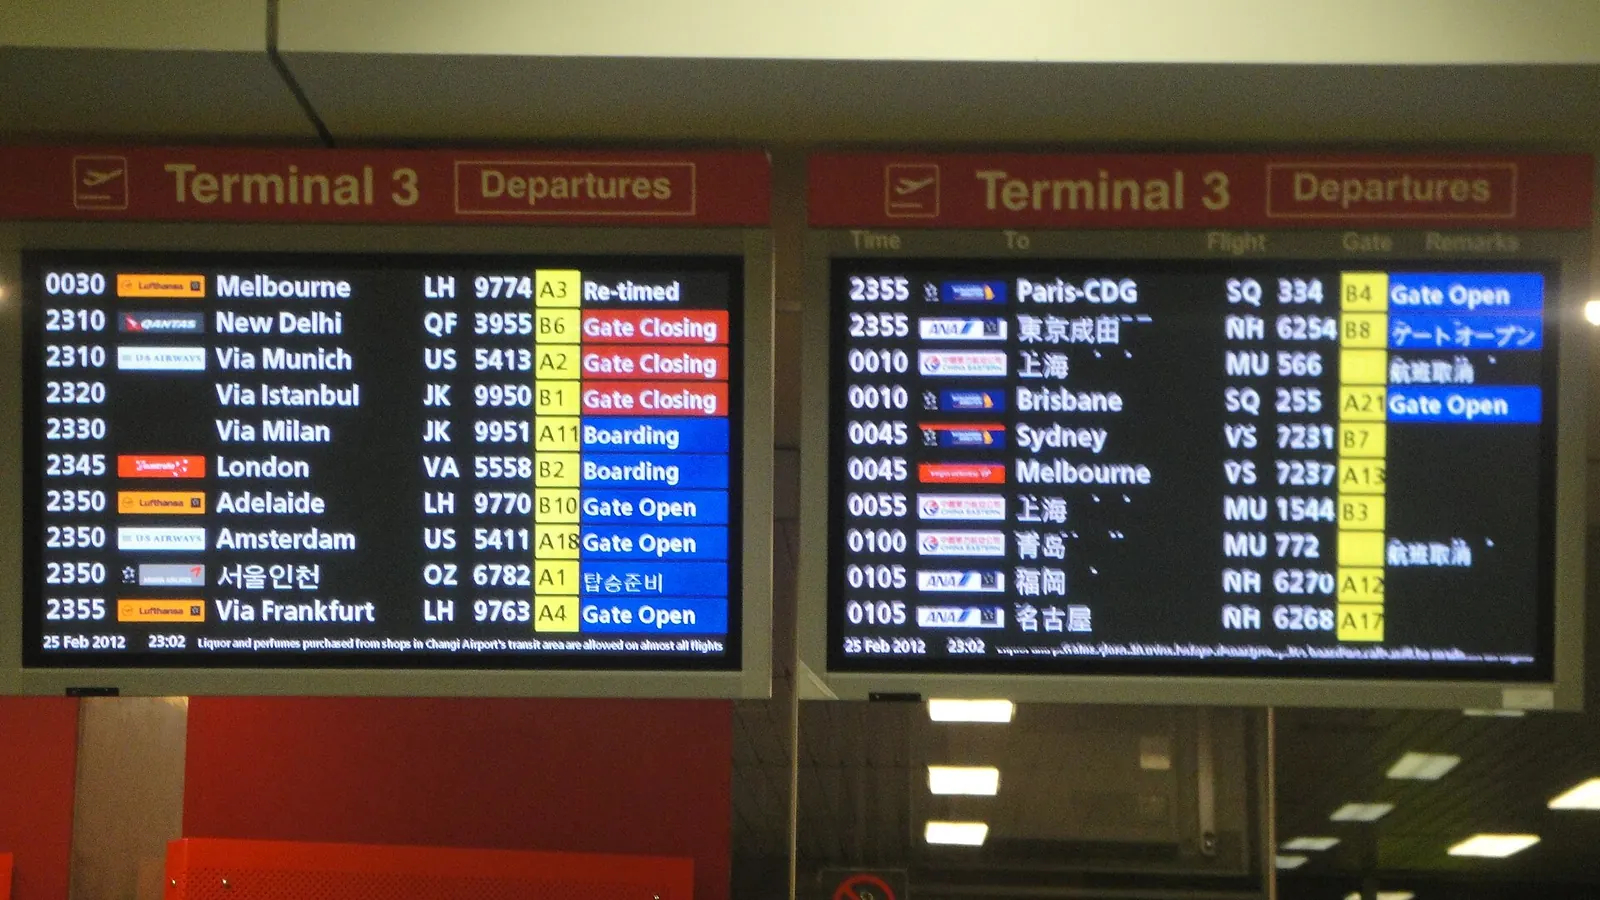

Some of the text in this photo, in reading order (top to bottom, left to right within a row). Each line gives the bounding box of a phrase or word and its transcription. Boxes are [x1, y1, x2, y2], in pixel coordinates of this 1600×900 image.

[164, 163, 419, 207] Terminal 3
[480, 169, 672, 204] Departures
[976, 170, 1230, 212] Terminal 3
[1292, 172, 1491, 208] Departures
[851, 230, 901, 250] Time
[1005, 231, 1030, 249] To
[1207, 232, 1267, 255] Flight
[1342, 233, 1393, 251] Gate
[1425, 234, 1520, 252] Remarks
[46, 272, 105, 294] 0030
[217, 274, 351, 297] Melbourne
[425, 276, 532, 298] LH 9774
[540, 282, 566, 297] A3
[584, 281, 679, 301] Re-timed
[851, 277, 909, 301] 2355
[1017, 279, 1137, 303] Paris-CDG
[1227, 279, 1323, 306] SQ 334
[1346, 285, 1371, 301] B4
[1388, 284, 1510, 310] Gate Open
[46, 309, 105, 330] 2310
[142, 319, 197, 330] QANTAS
[217, 311, 341, 333] New Delhi
[424, 312, 532, 336] QF 3955
[541, 318, 564, 333] B6
[584, 317, 717, 342] Gate Closing
[850, 313, 908, 336] 2355
[929, 324, 959, 335] ANA
[1017, 315, 1119, 344] 東京成田
[1226, 316, 1338, 340] NH 6254
[1346, 322, 1370, 338] B8
[1393, 322, 1535, 346] ゲートオープン
[47, 345, 105, 367] 2310
[216, 347, 351, 370] Via Munich
[425, 348, 531, 370] US 5413
[540, 354, 566, 369] A2
[584, 353, 716, 378] Gate Closing
[849, 349, 908, 373] 0010
[1018, 351, 1068, 379] 上海
[1226, 352, 1322, 376] MU 566
[47, 382, 105, 403] 2320
[216, 383, 359, 405] Via Istanbul
[424, 384, 532, 406] JK 9950
[540, 390, 564, 405] B1
[583, 390, 716, 414] Gate Closing
[849, 385, 908, 408] 0010
[1017, 387, 1122, 411] Brisbane
[1226, 388, 1321, 415] SQ 255
[1344, 395, 1384, 411] A21
[1386, 394, 1508, 419] Gate Open
[47, 418, 105, 439] 2330
[216, 419, 330, 441] Via Milan
[423, 420, 528, 442] JK 9951
[540, 426, 579, 442] A11
[584, 425, 679, 449] Boarding
[848, 421, 907, 445] 0045
[1017, 423, 1107, 453] Sydney
[1225, 424, 1333, 449] VS 7231
[1344, 431, 1369, 447] B7
[47, 454, 105, 475] 2345
[218, 455, 309, 477] London
[423, 456, 531, 478] VA 5558
[540, 461, 563, 477] B2
[584, 461, 679, 485] Boarding
[848, 457, 907, 480] 0045
[1016, 459, 1151, 484] Melbourne
[1224, 461, 1335, 485] VS 7237
[47, 490, 105, 511] 2350
[216, 491, 325, 513] Adelaide
[425, 492, 531, 514] LH 9770
[540, 497, 577, 513] B10
[583, 498, 696, 521] Gate Open
[848, 493, 907, 516] 0055
[1018, 495, 1067, 523] 上海
[1224, 497, 1335, 521] MU 1544
[1343, 504, 1368, 520] B3
[47, 526, 105, 547] 2350
[216, 528, 355, 549] Amsterdam
[425, 528, 528, 549] US 5411
[539, 533, 580, 550] A18
[583, 533, 696, 557] Gate Open
[848, 529, 906, 552] 0100
[1224, 532, 1319, 557] MU 772
[47, 562, 105, 583] 2350
[218, 564, 319, 589] 서울인천
[424, 564, 530, 585] OZ 6782
[539, 569, 563, 585] A1
[584, 573, 662, 592] 탑승준비
[847, 565, 906, 588] 0105
[1016, 567, 1065, 595] 福岡
[1223, 569, 1334, 593] NH 6270
[47, 599, 105, 619] 2355
[216, 599, 374, 621] Via Frankfurt
[425, 600, 530, 621] LH 9763
[539, 605, 565, 621] A4
[582, 605, 695, 628] Gate Open
[848, 601, 906, 624] 0105
[926, 612, 956, 623] ANA
[1016, 605, 1092, 632] 名古屋
[1223, 605, 1334, 630] NH 6268
[1342, 613, 1384, 629] A17
[43, 636, 126, 649] 25 Feb 2012
[148, 635, 186, 648] 23:02
[198, 638, 723, 652] Liquor and perfumes purchased from shops Changi Airport's transit allowed almost flights
[948, 638, 985, 654] 23:02
